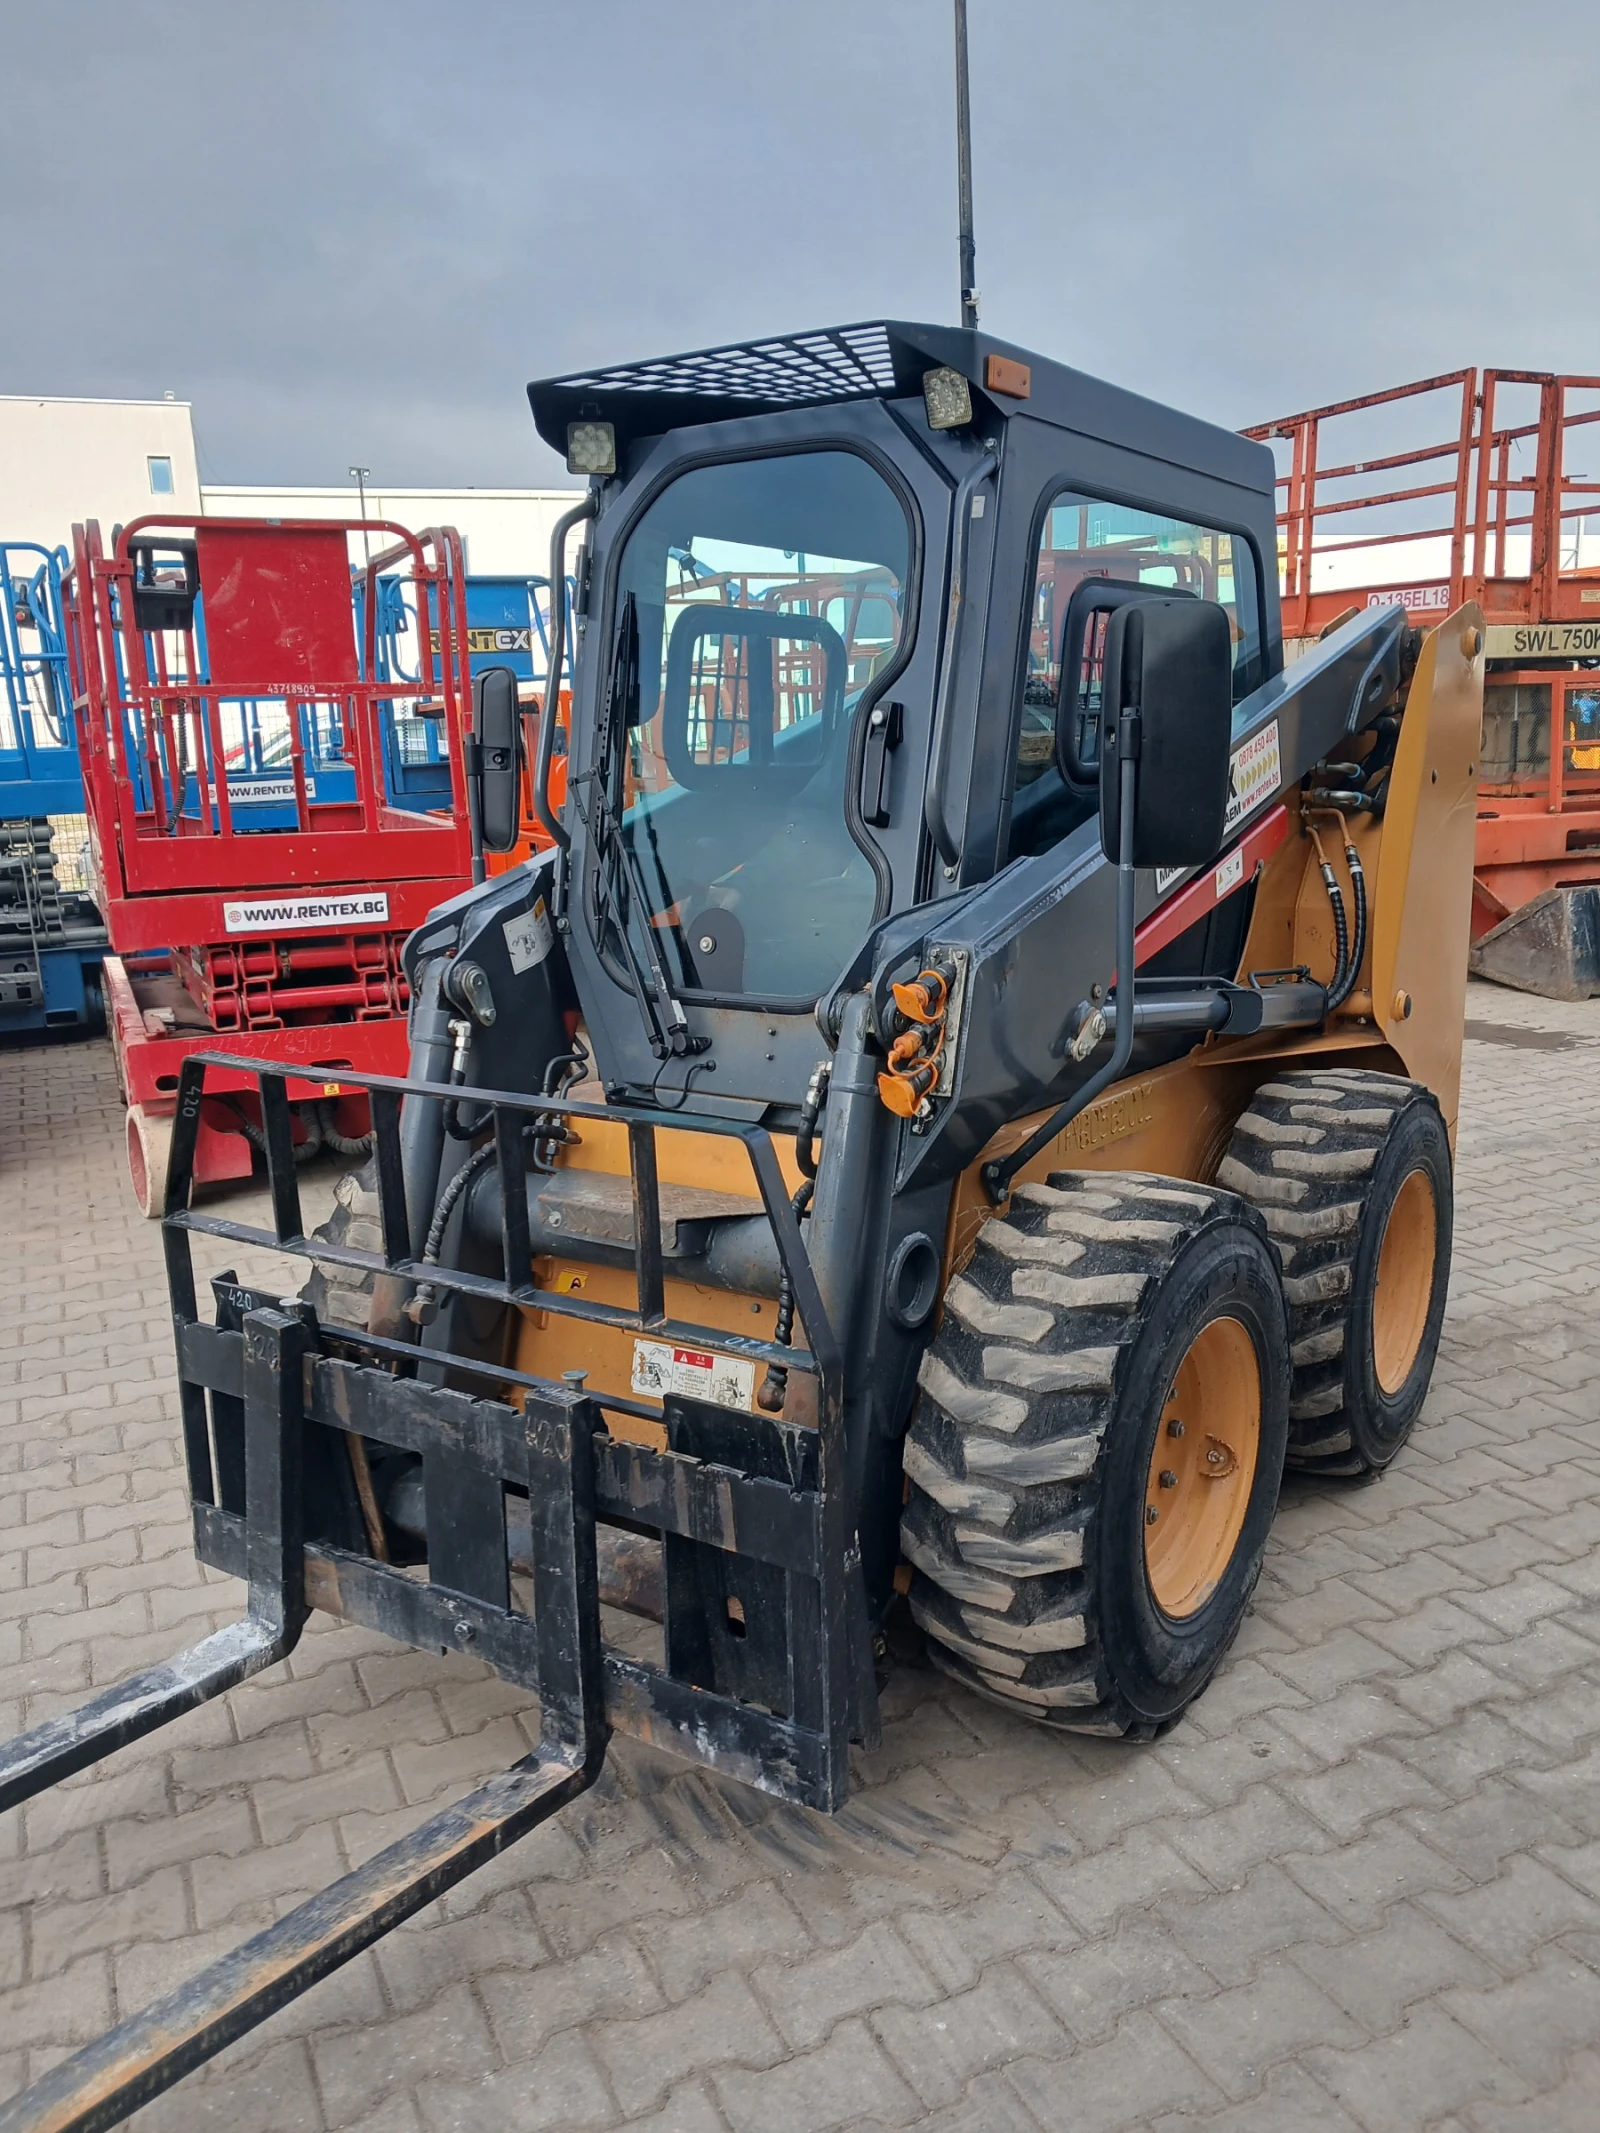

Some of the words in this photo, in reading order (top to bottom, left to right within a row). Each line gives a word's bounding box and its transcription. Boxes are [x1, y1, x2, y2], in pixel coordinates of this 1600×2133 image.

[1514, 630, 1559, 652] SWL
[267, 684, 315, 694] 43718909
[1254, 735, 1265, 754] 450
[1266, 726, 1276, 743] 400
[244, 901, 384, 921] WWW.RENTEX.BG
[183, 1086, 201, 1117] 420
[228, 1288, 252, 1310] 420
